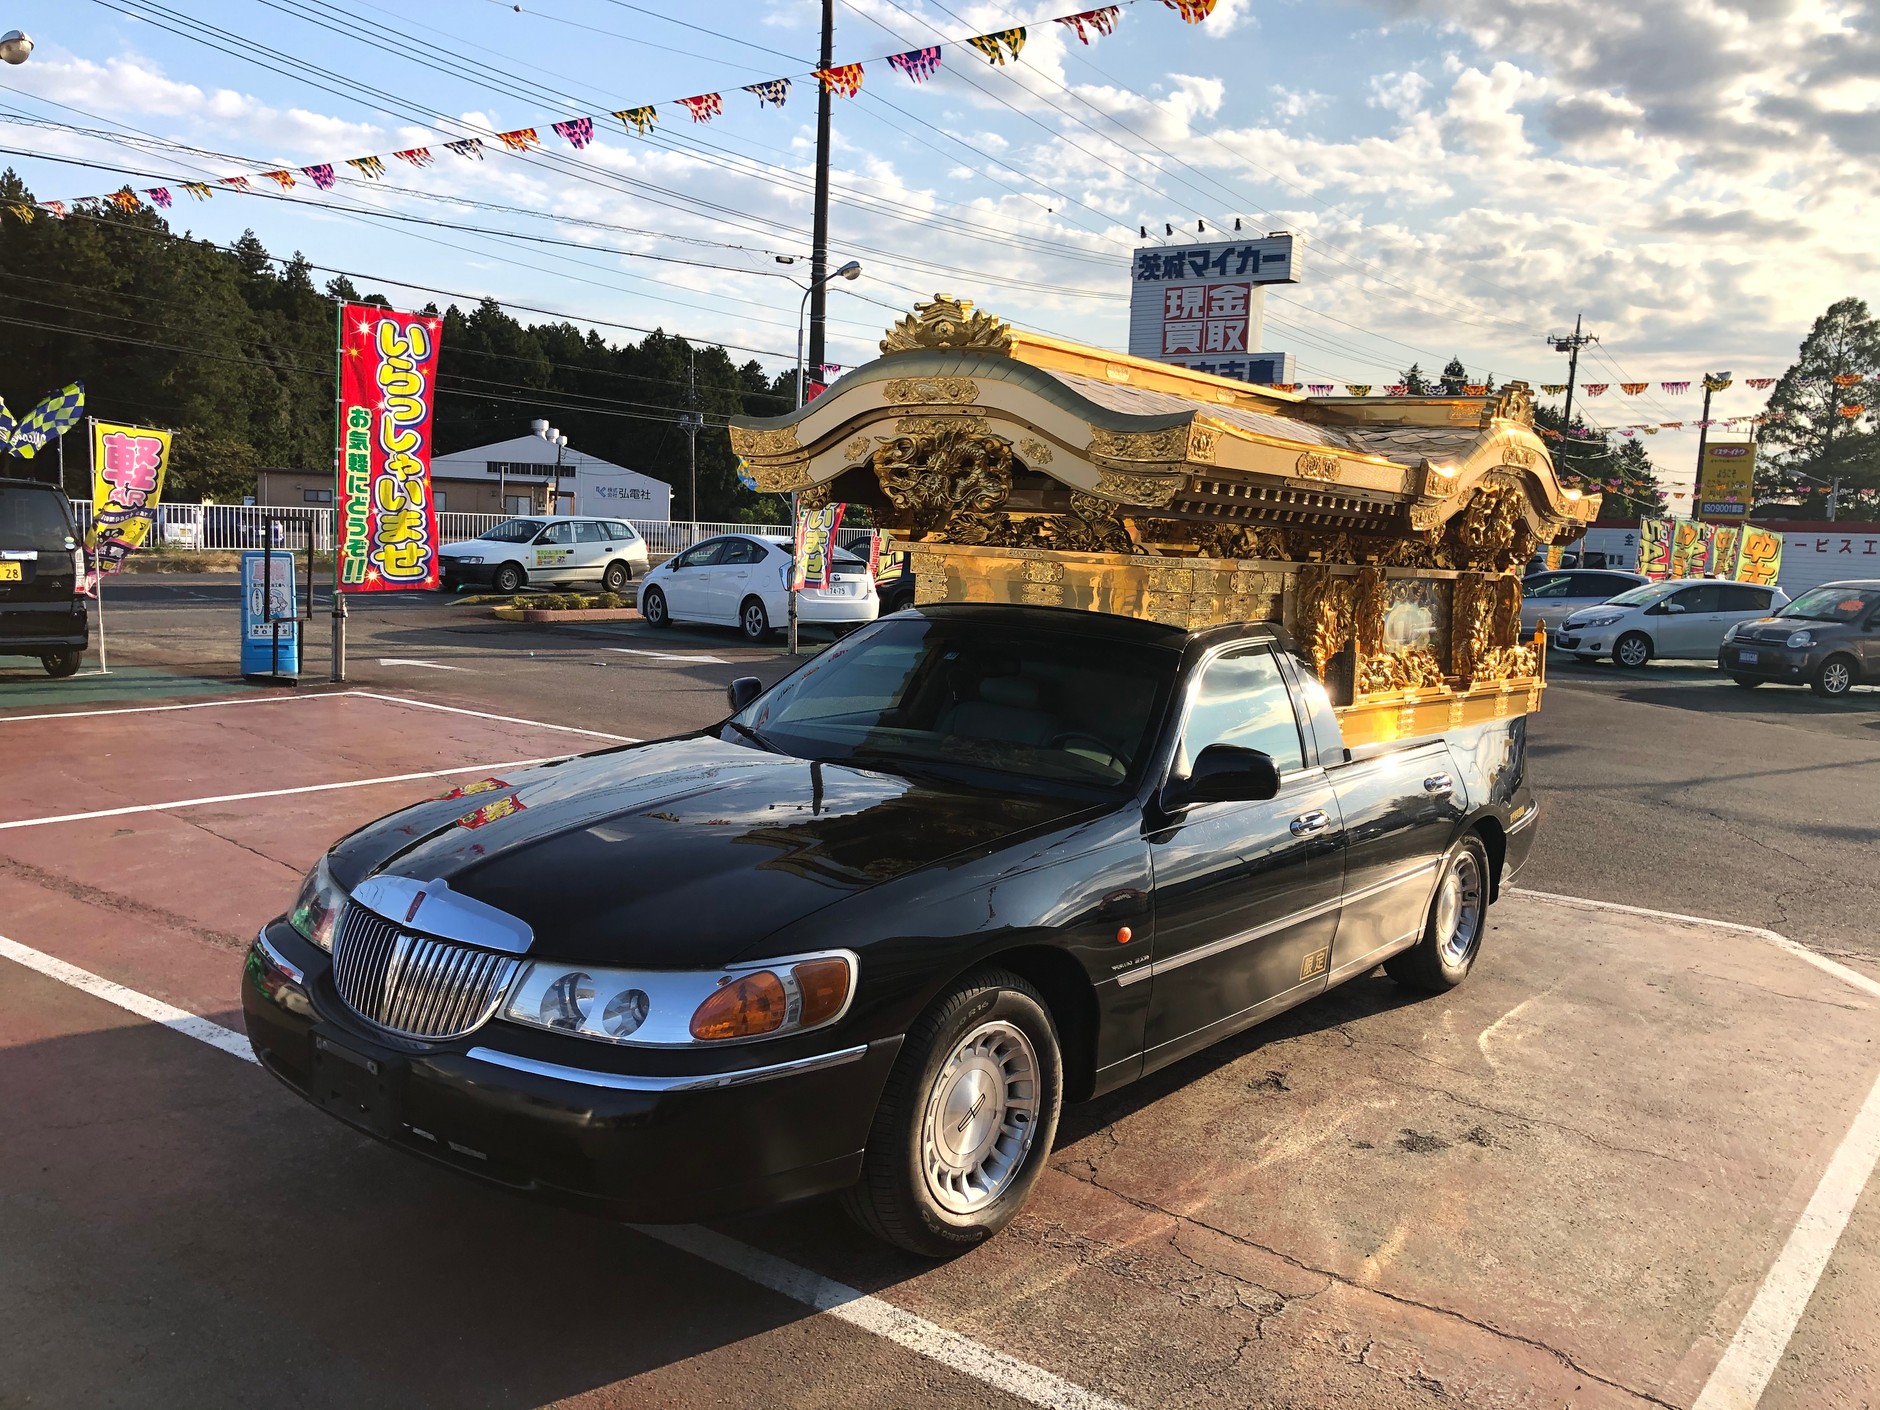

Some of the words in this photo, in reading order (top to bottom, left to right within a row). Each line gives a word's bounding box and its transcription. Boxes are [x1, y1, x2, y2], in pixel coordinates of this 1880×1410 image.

[1138, 247, 1285, 280] 茨城マイカー
[1165, 285, 1248, 319] 現金
[1164, 320, 1245, 353] 買取
[102, 433, 162, 491] 軽
[370, 319, 430, 581] いらっしゃいませ
[1783, 539, 1877, 554] ービスエ
